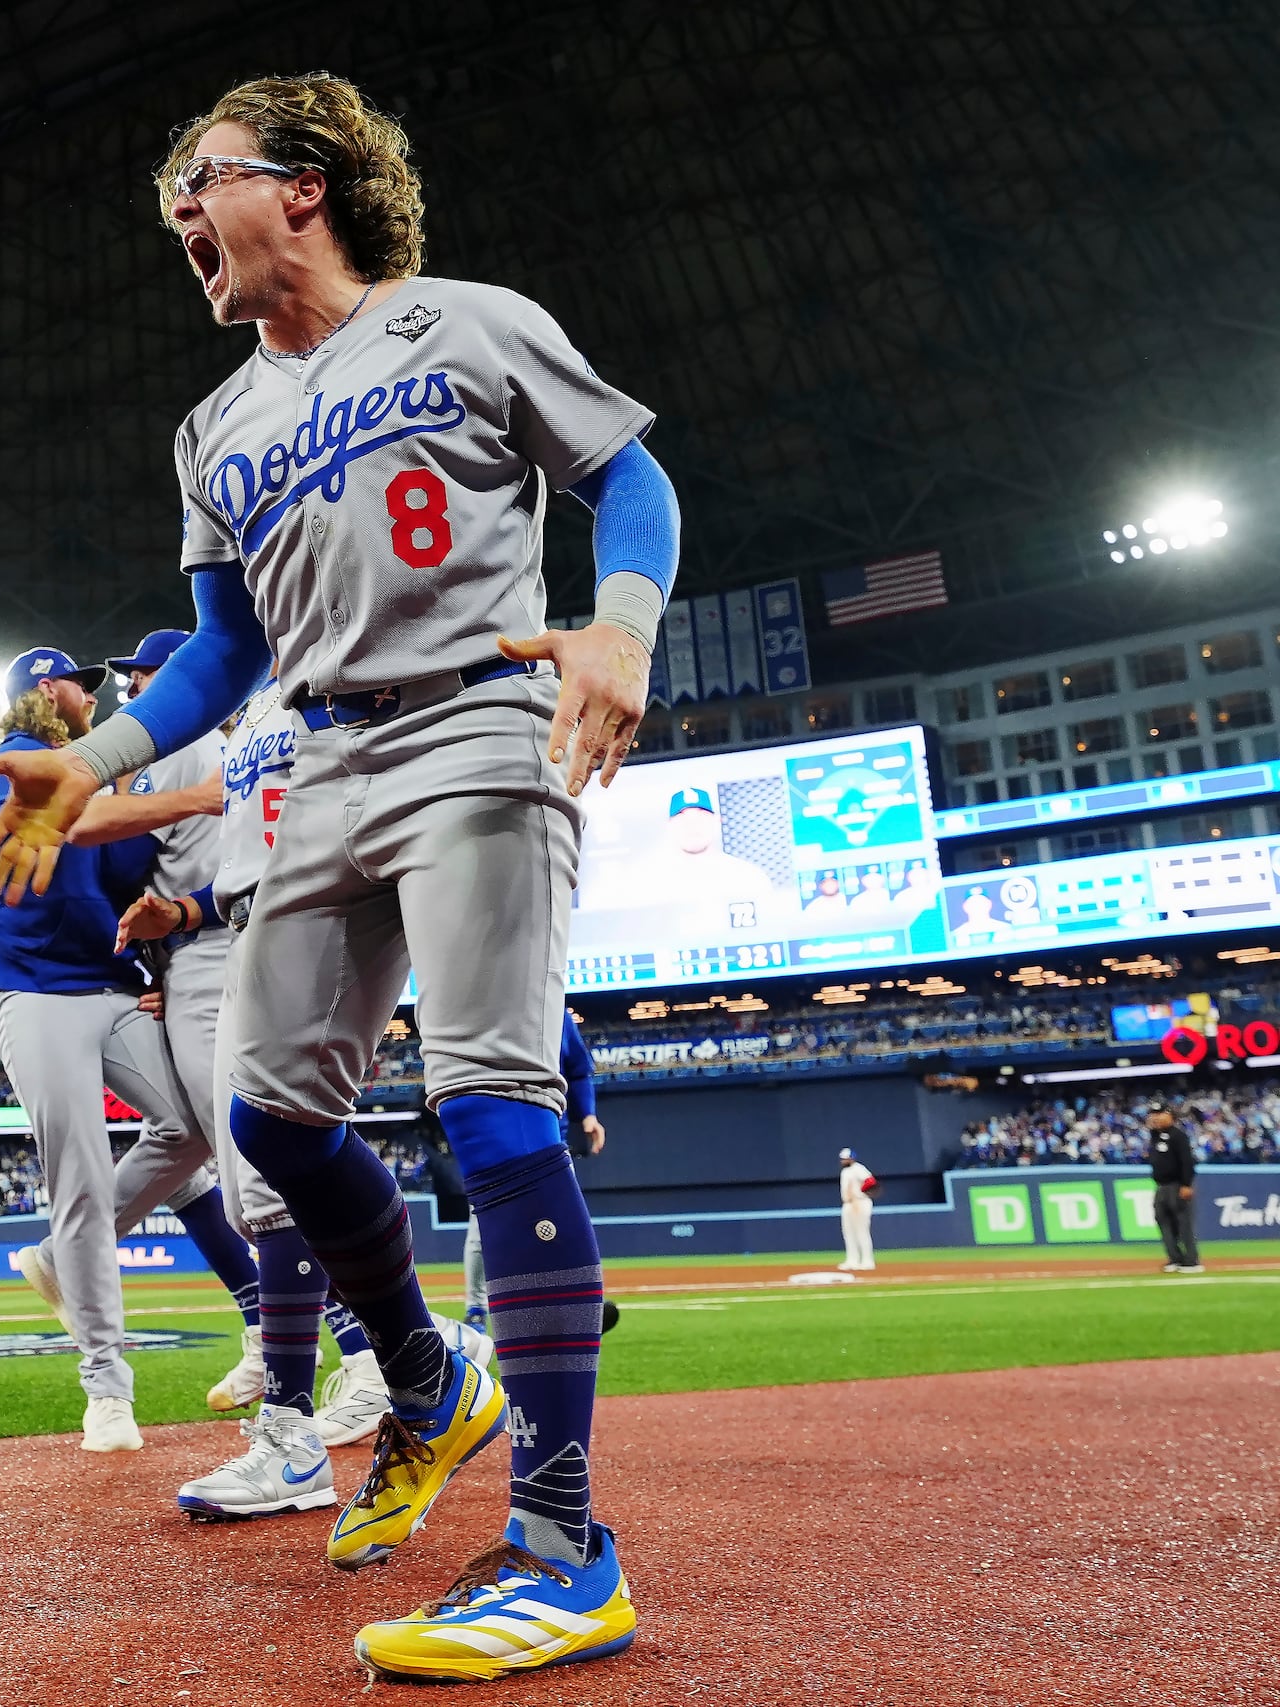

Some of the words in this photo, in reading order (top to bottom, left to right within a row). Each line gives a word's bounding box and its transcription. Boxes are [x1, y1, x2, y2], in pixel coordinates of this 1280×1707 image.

[208, 371, 466, 557] Dodgers
[385, 468, 453, 569] 8
[764, 626, 803, 658] 32
[221, 729, 296, 801] odger
[976, 1196, 1026, 1232] TD
[1047, 1193, 1100, 1231] TD
